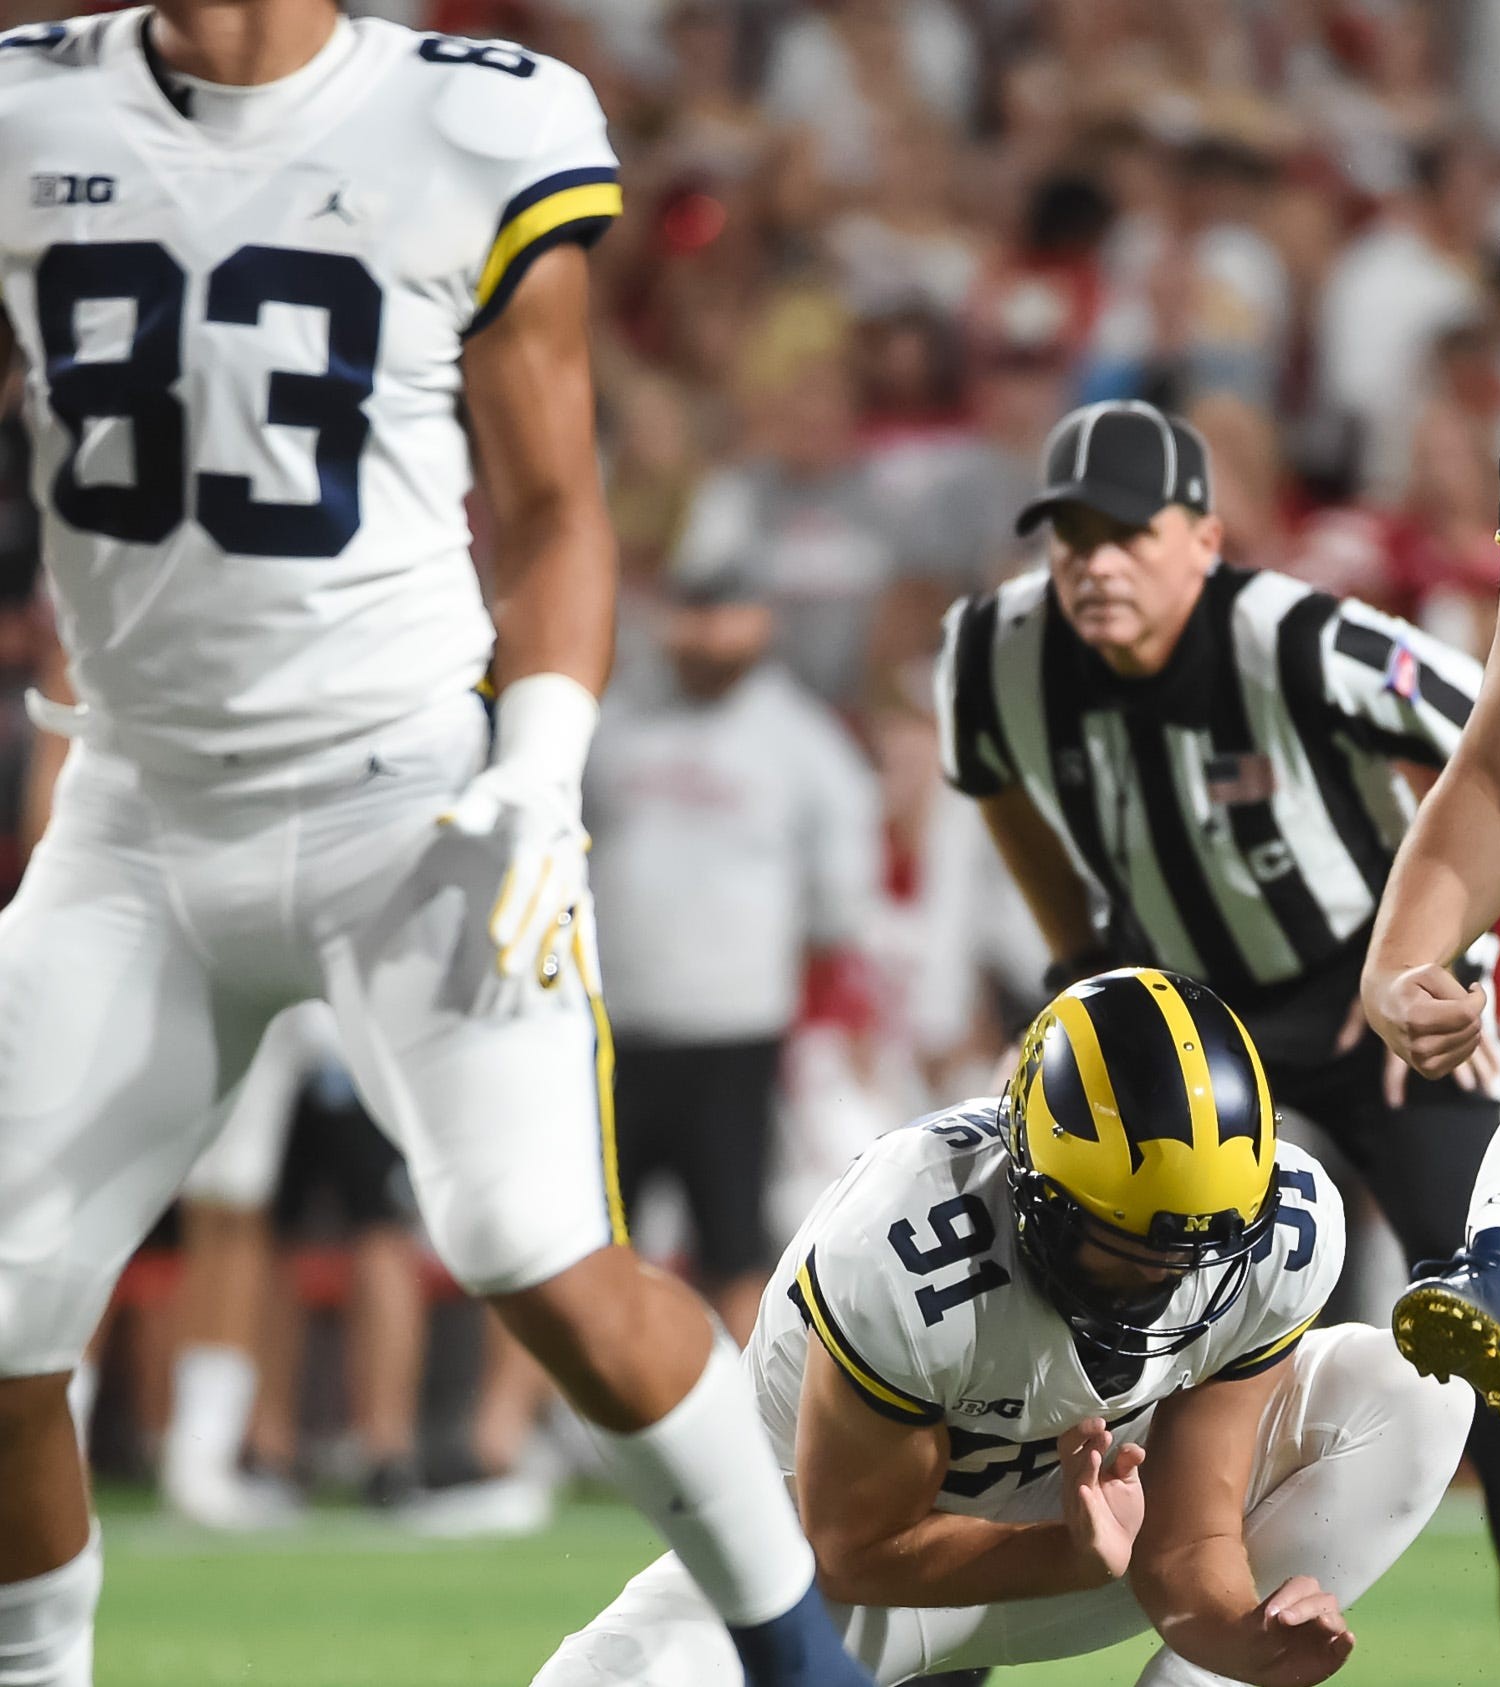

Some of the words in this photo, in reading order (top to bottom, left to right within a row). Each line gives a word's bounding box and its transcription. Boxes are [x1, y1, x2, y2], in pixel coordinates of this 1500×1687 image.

[35, 241, 383, 558] 83
[887, 1193, 1012, 1328] 91
[1183, 1215, 1212, 1232] M
